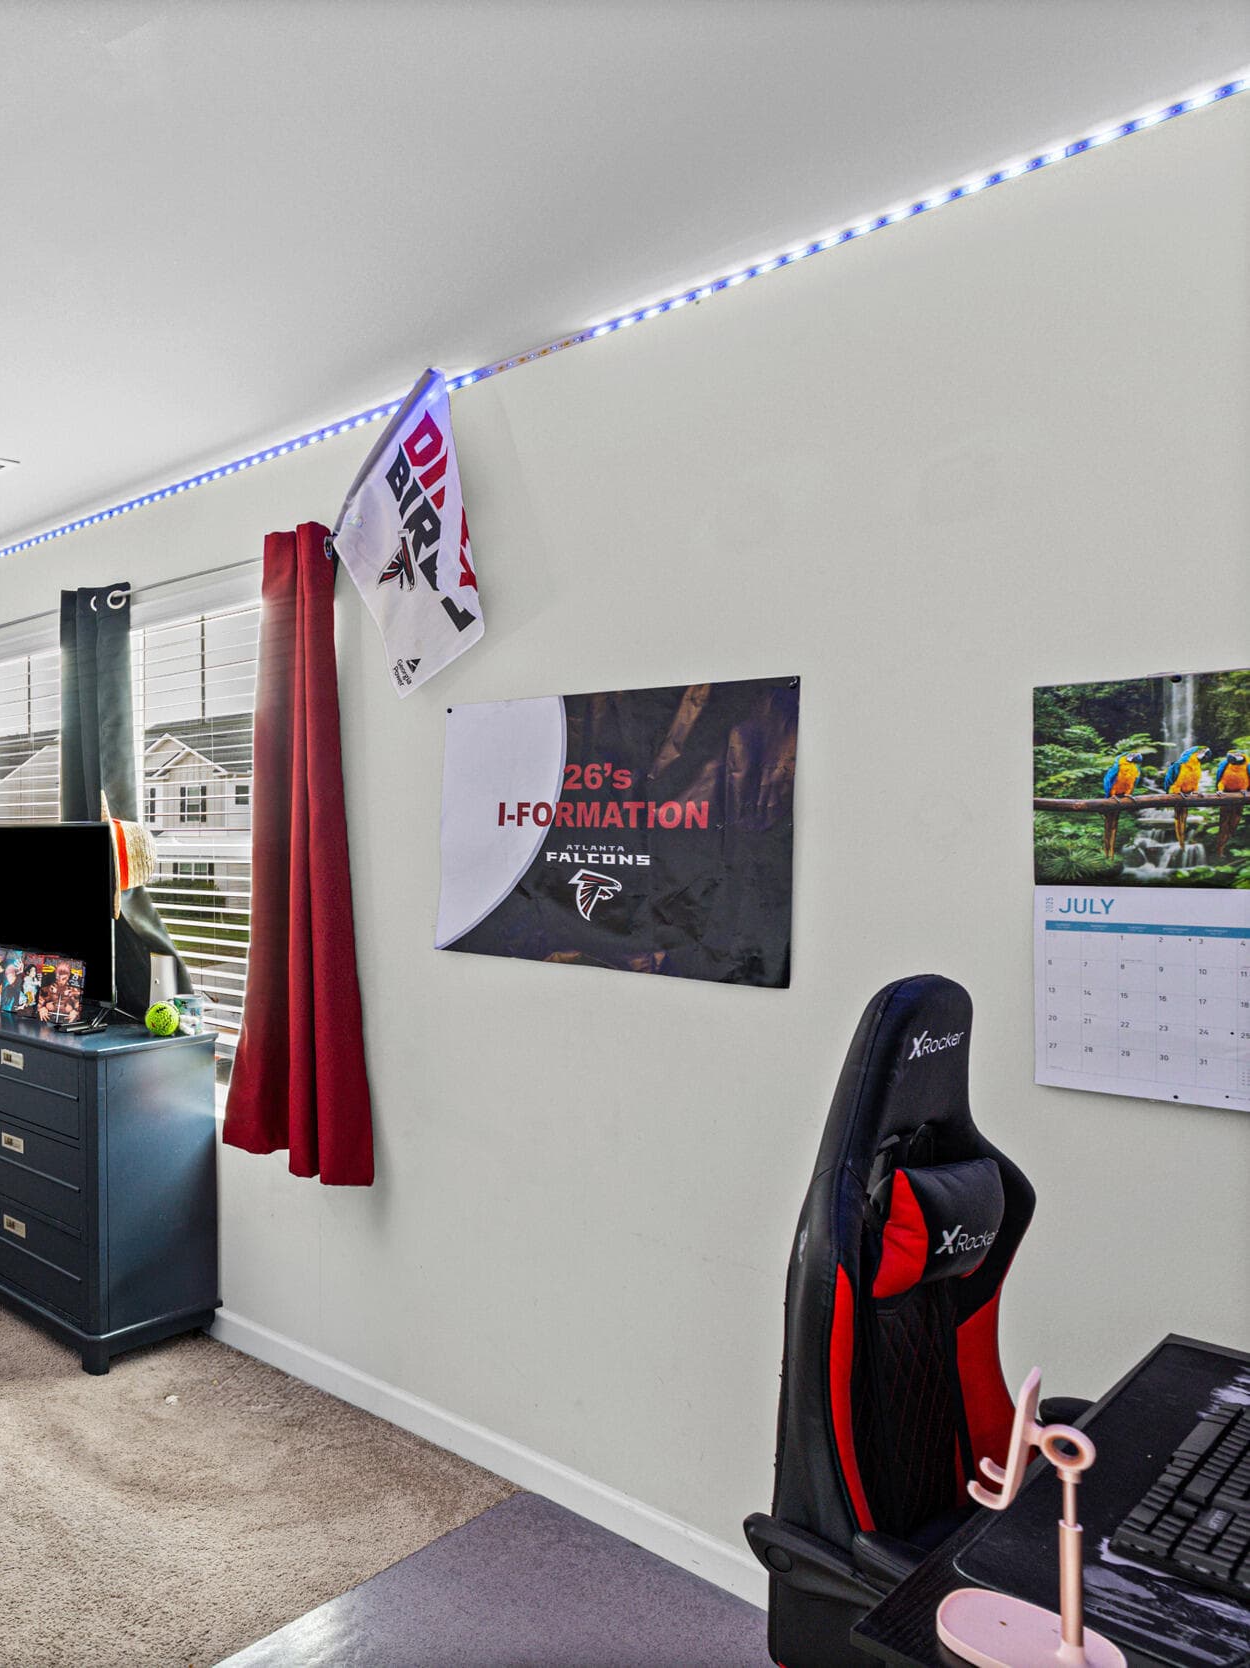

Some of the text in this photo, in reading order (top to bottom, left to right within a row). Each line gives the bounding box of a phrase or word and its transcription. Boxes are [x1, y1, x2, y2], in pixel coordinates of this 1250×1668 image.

[563, 763, 632, 790] 26's
[498, 801, 709, 830] I-FORMATION
[566, 844, 625, 852] ATLANTA
[546, 852, 651, 866] FALCONS
[1058, 897, 1115, 915] JULY
